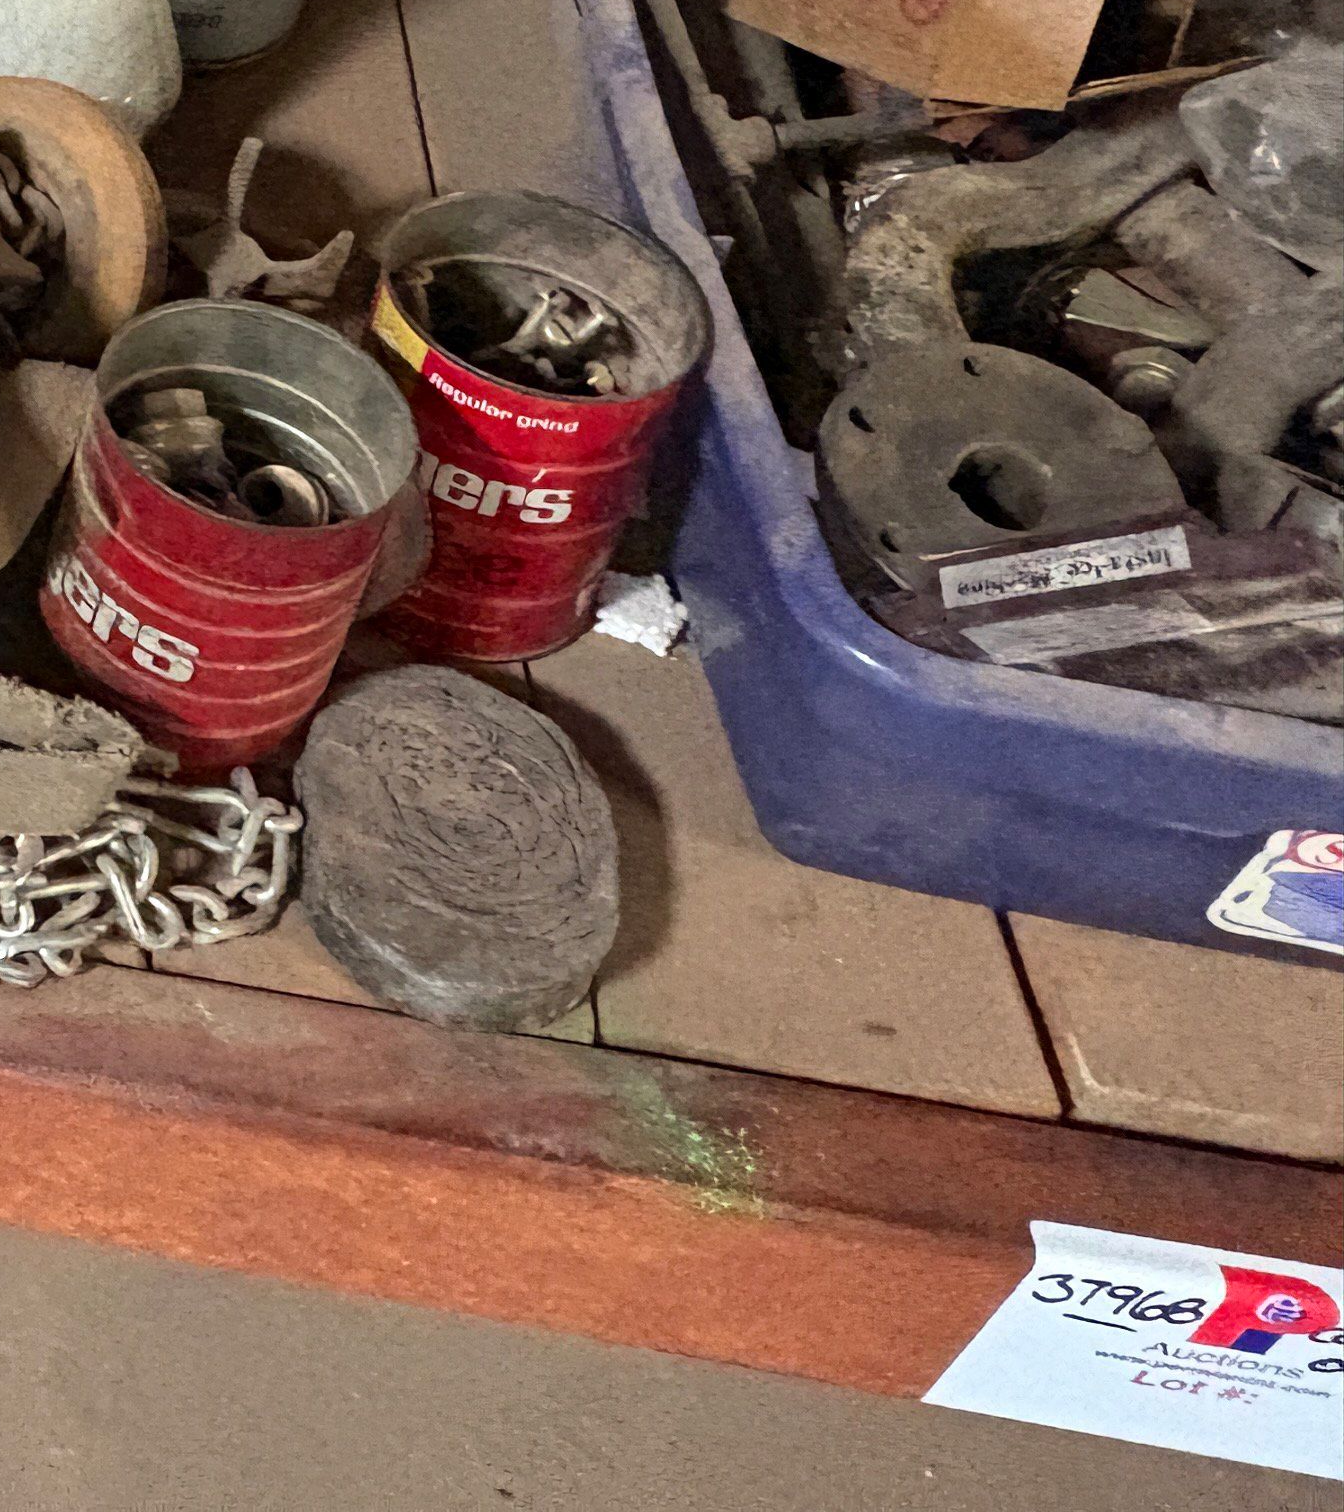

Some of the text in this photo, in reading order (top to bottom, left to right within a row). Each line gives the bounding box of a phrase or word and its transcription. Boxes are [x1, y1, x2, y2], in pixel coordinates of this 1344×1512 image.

[428, 372, 580, 434] Regular grind
[1031, 1273, 1207, 1325] 37968
[1142, 1341, 1305, 1379] Auctions
